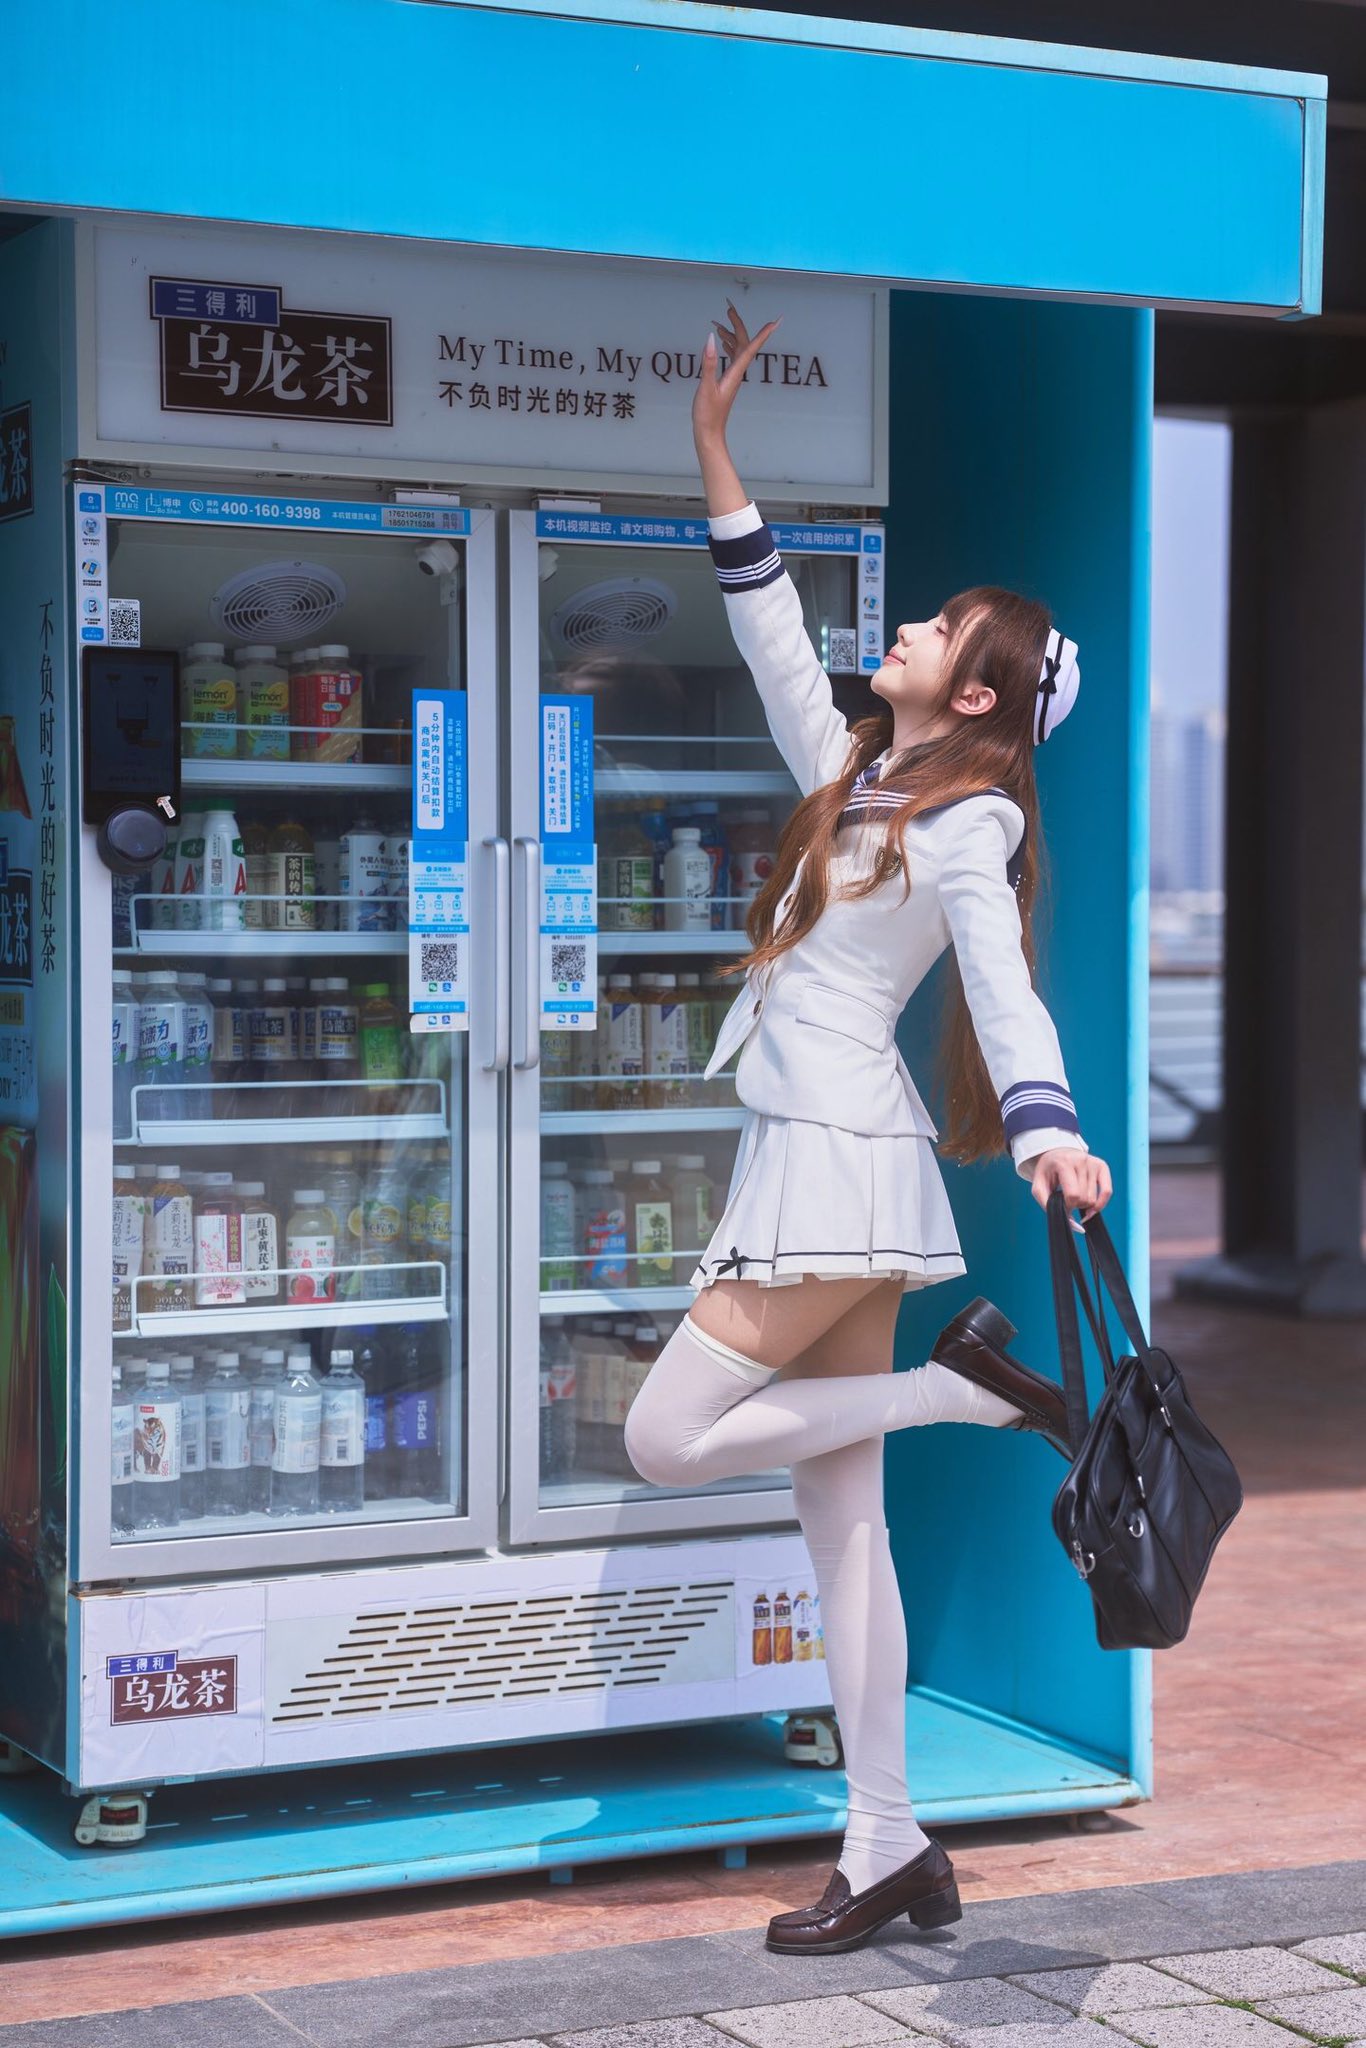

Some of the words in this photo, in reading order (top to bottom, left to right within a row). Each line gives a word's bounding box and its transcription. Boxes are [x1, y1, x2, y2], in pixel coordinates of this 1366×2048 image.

[175, 287, 257, 320] 三得利
[178, 323, 374, 408] 乌龙茶
[437, 334, 486, 371] My
[494, 337, 586, 375] Time,
[596, 347, 641, 382] My
[437, 380, 637, 420] 不负时光的好茶
[221, 501, 321, 521] 400-160-9398
[544, 518, 711, 539] 本机视频监控，请文明购物，每一
[193, 688, 227, 700] lemon
[250, 689, 283, 701] lemon
[39, 598, 57, 975] 不负时光的好茶
[417, 1400, 428, 1440] PEPSI
[119, 1655, 165, 1673] 三得利
[120, 1667, 228, 1713] 乌龙茶
